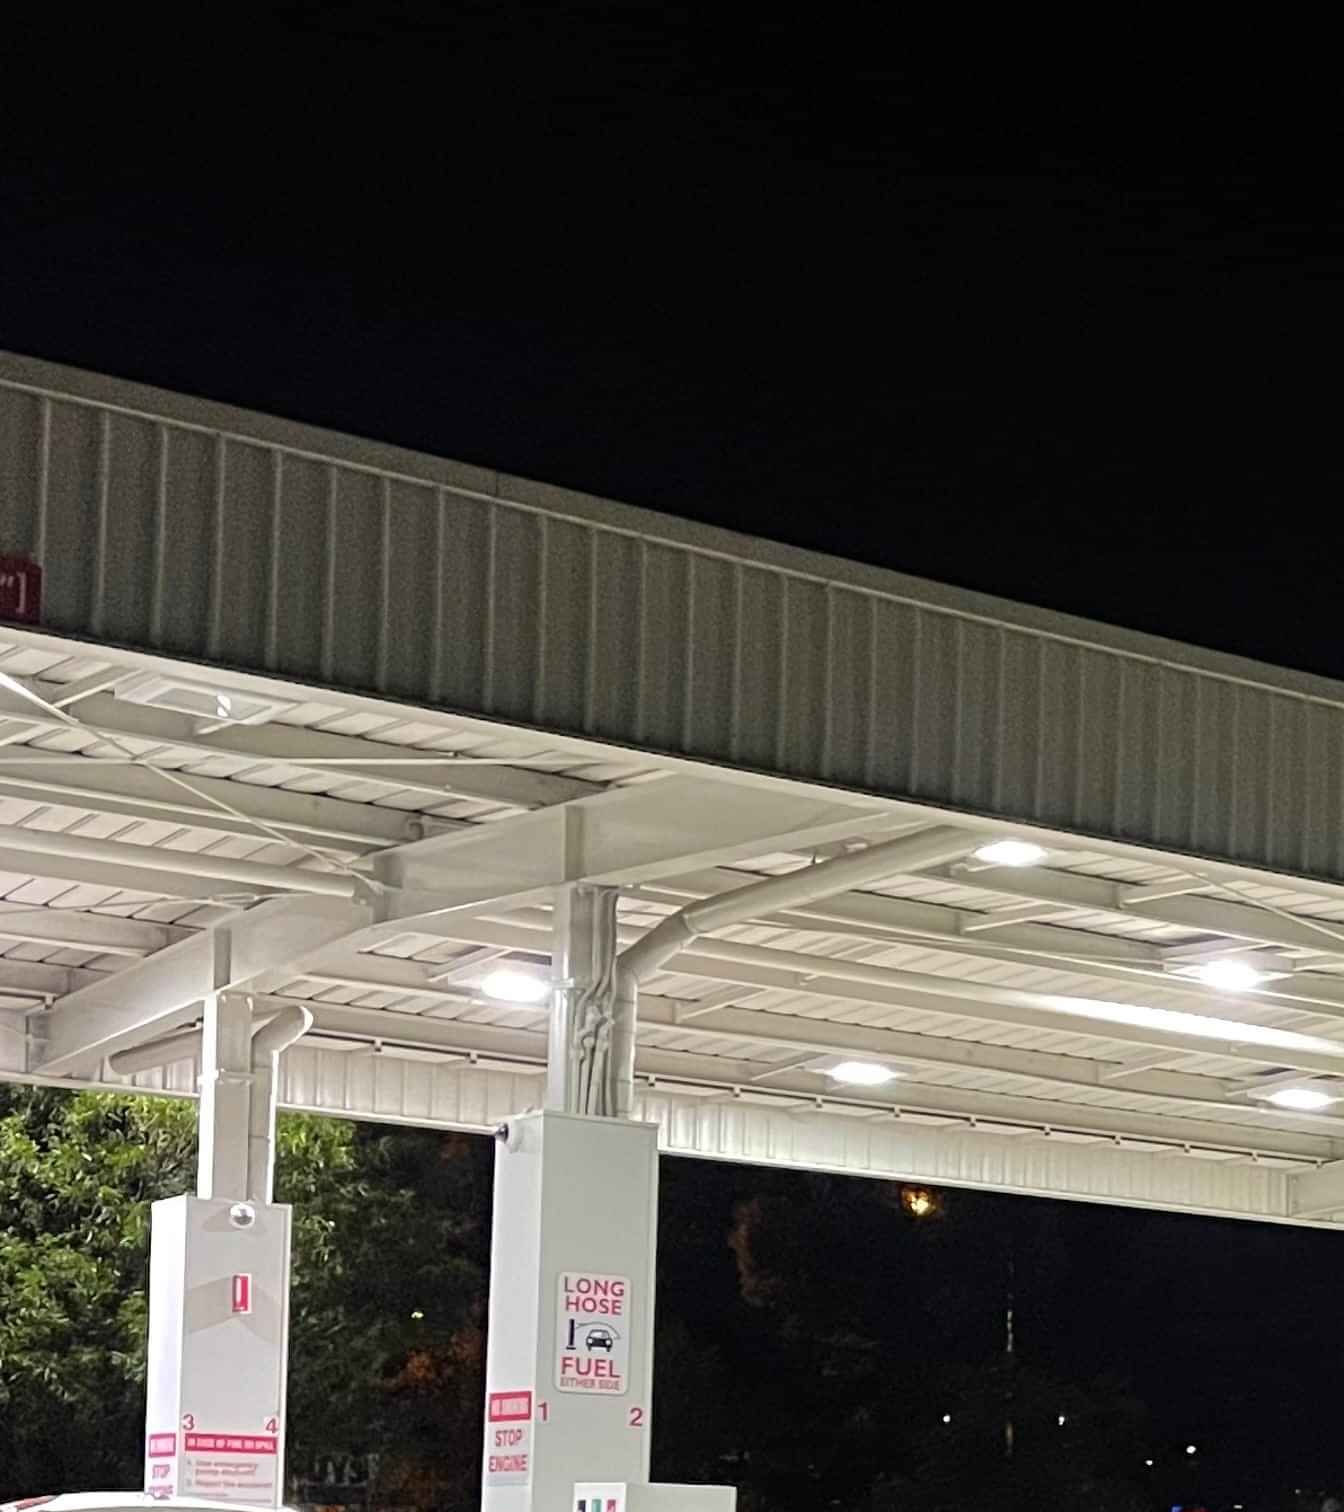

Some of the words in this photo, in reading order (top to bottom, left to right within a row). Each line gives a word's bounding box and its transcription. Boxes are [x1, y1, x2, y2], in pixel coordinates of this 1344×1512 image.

[564, 1276, 625, 1296] LONG
[565, 1295, 622, 1316] HOSE
[561, 1356, 621, 1379] FUEL
[538, 1402, 548, 1421] 1
[629, 1407, 643, 1426] 2
[183, 1414, 195, 1431] 3
[265, 1418, 278, 1434] 4
[495, 1429, 522, 1447] STOP
[489, 1455, 528, 1472] ENGINE
